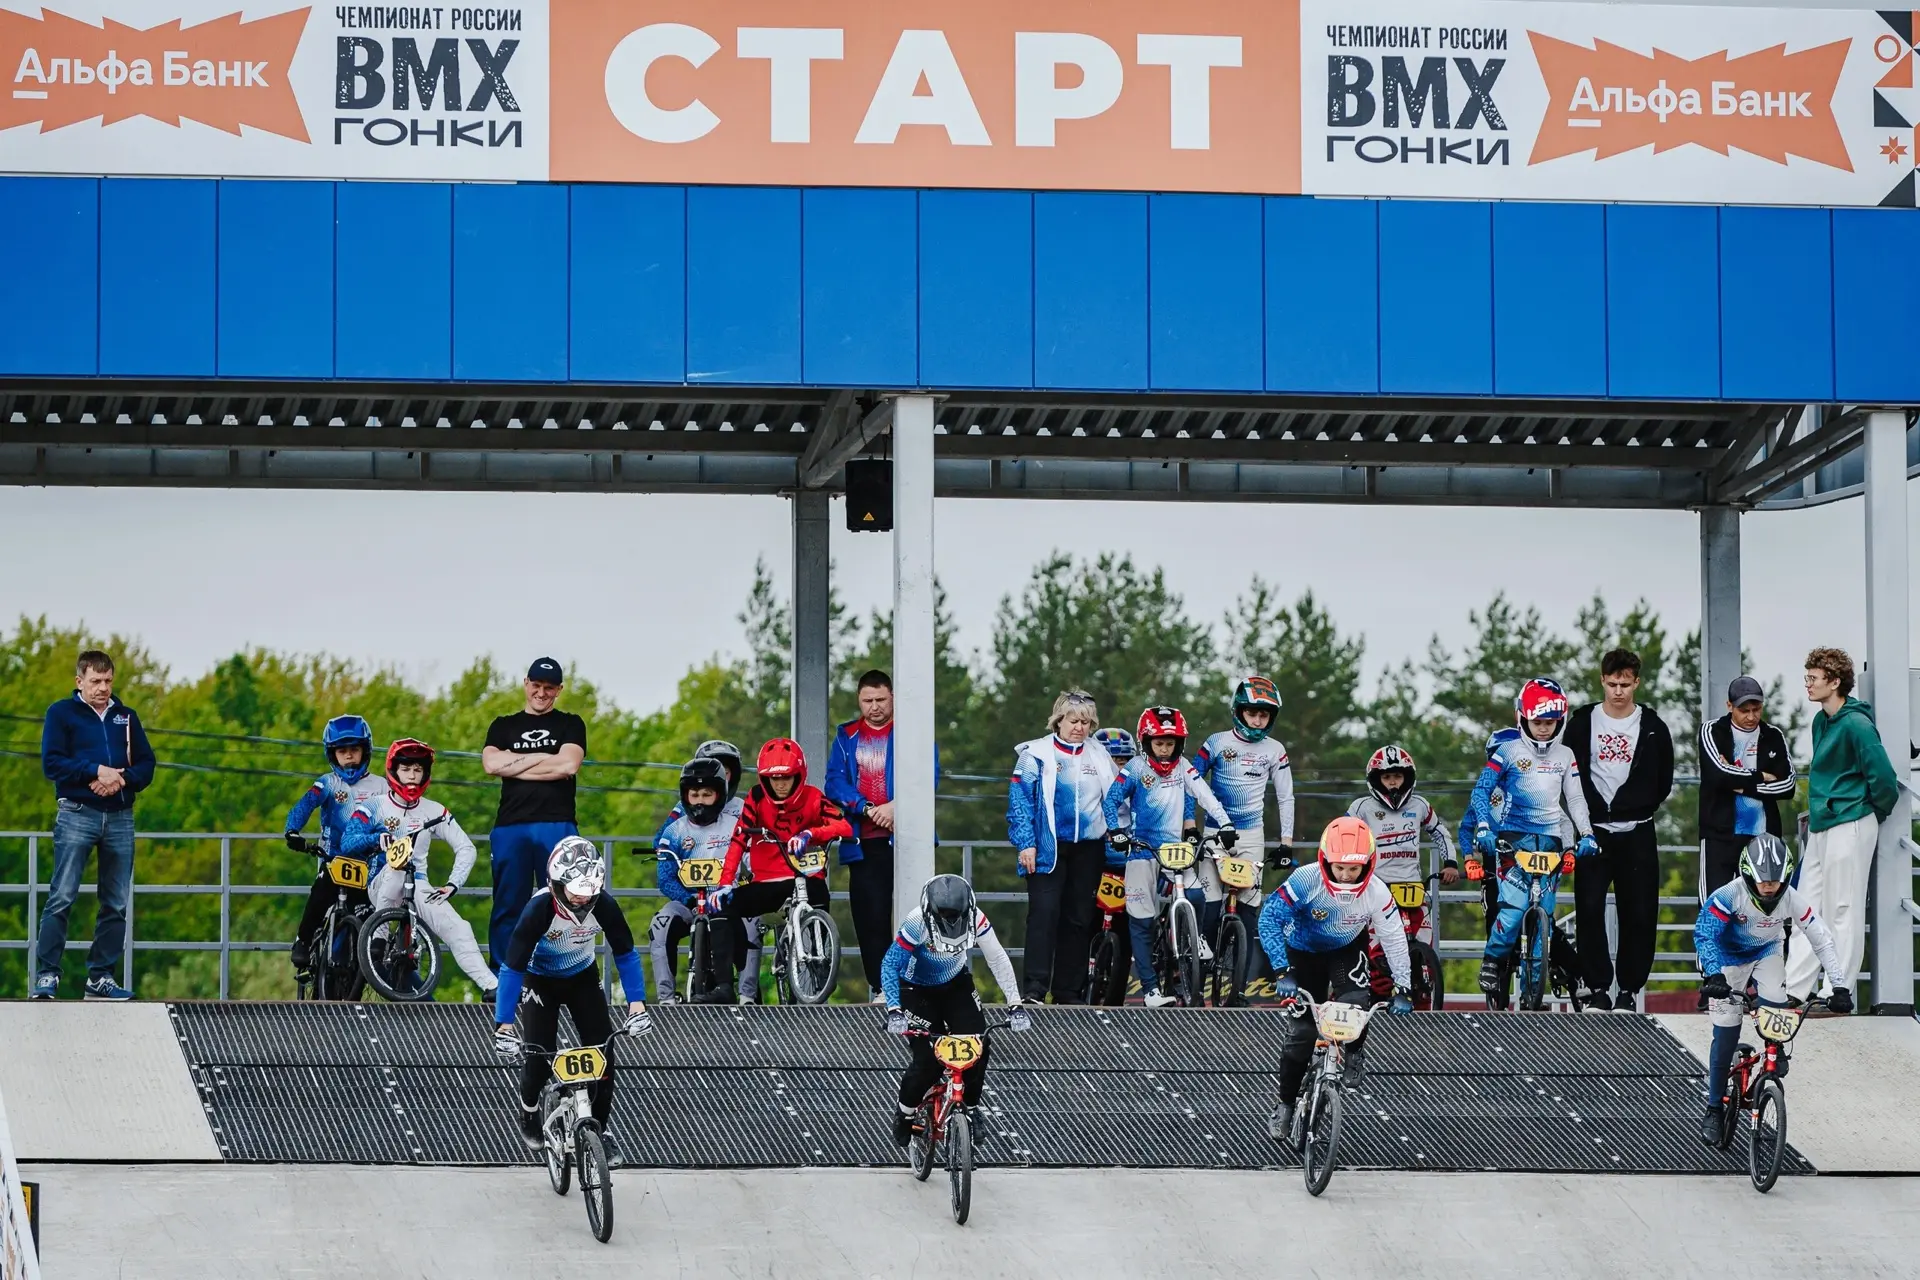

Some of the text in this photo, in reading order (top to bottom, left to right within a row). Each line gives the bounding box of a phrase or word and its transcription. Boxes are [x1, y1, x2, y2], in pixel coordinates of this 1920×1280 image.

[335, 5, 522, 31] ЧЕМПИОНАТ РОССИИ
[1326, 25, 1508, 51] ЧЕМПИОНАТ РОССИИ
[13, 48, 270, 99] Альфа Банк
[604, 22, 1243, 150] СТАРТ
[1568, 77, 1812, 127] Альфа Банк
[334, 118, 523, 148] ГОНКИ
[1326, 135, 1510, 166] ГОНКИ
[513, 739, 557, 749] OAKLEY
[391, 842, 406, 862] 39
[1168, 848, 1186, 861] 111
[1528, 853, 1548, 871] 40
[341, 862, 361, 883] 61
[690, 863, 713, 881] 62
[1230, 863, 1245, 873] 37
[1101, 882, 1125, 899] 30
[1399, 886, 1416, 903] 77
[1334, 1010, 1348, 1023] 11
[1763, 1013, 1793, 1036] 785
[948, 1040, 974, 1061] 13
[565, 1053, 594, 1076] 66
